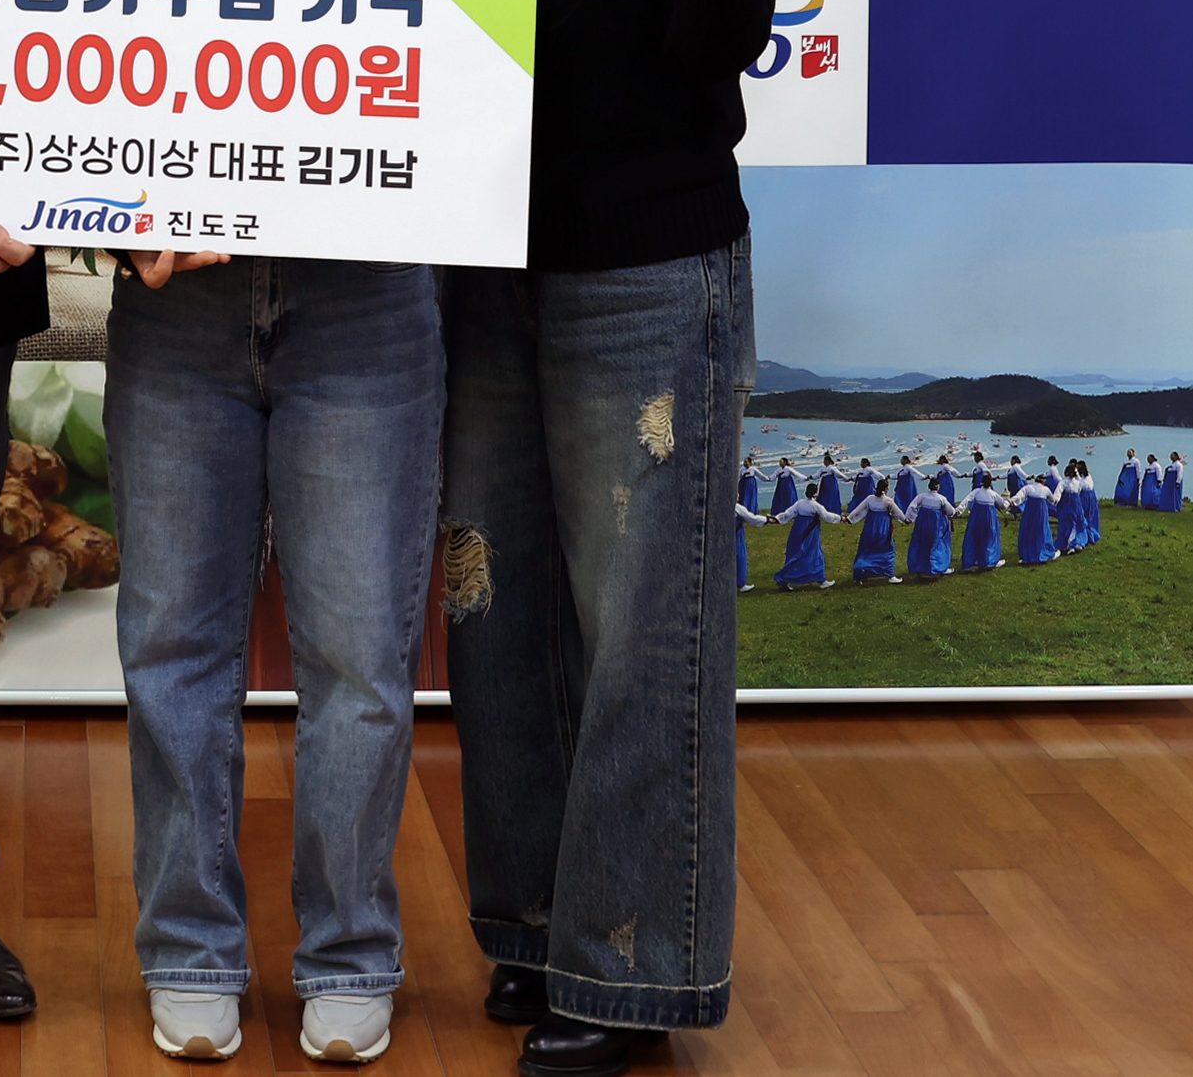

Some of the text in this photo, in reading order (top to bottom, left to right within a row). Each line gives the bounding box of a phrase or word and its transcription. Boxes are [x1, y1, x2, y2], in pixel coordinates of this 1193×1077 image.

[209, 142, 286, 182] 대표
[298, 145, 418, 190] 김기남
[21, 200, 132, 234] Jindo
[168, 210, 260, 241] 진도군
